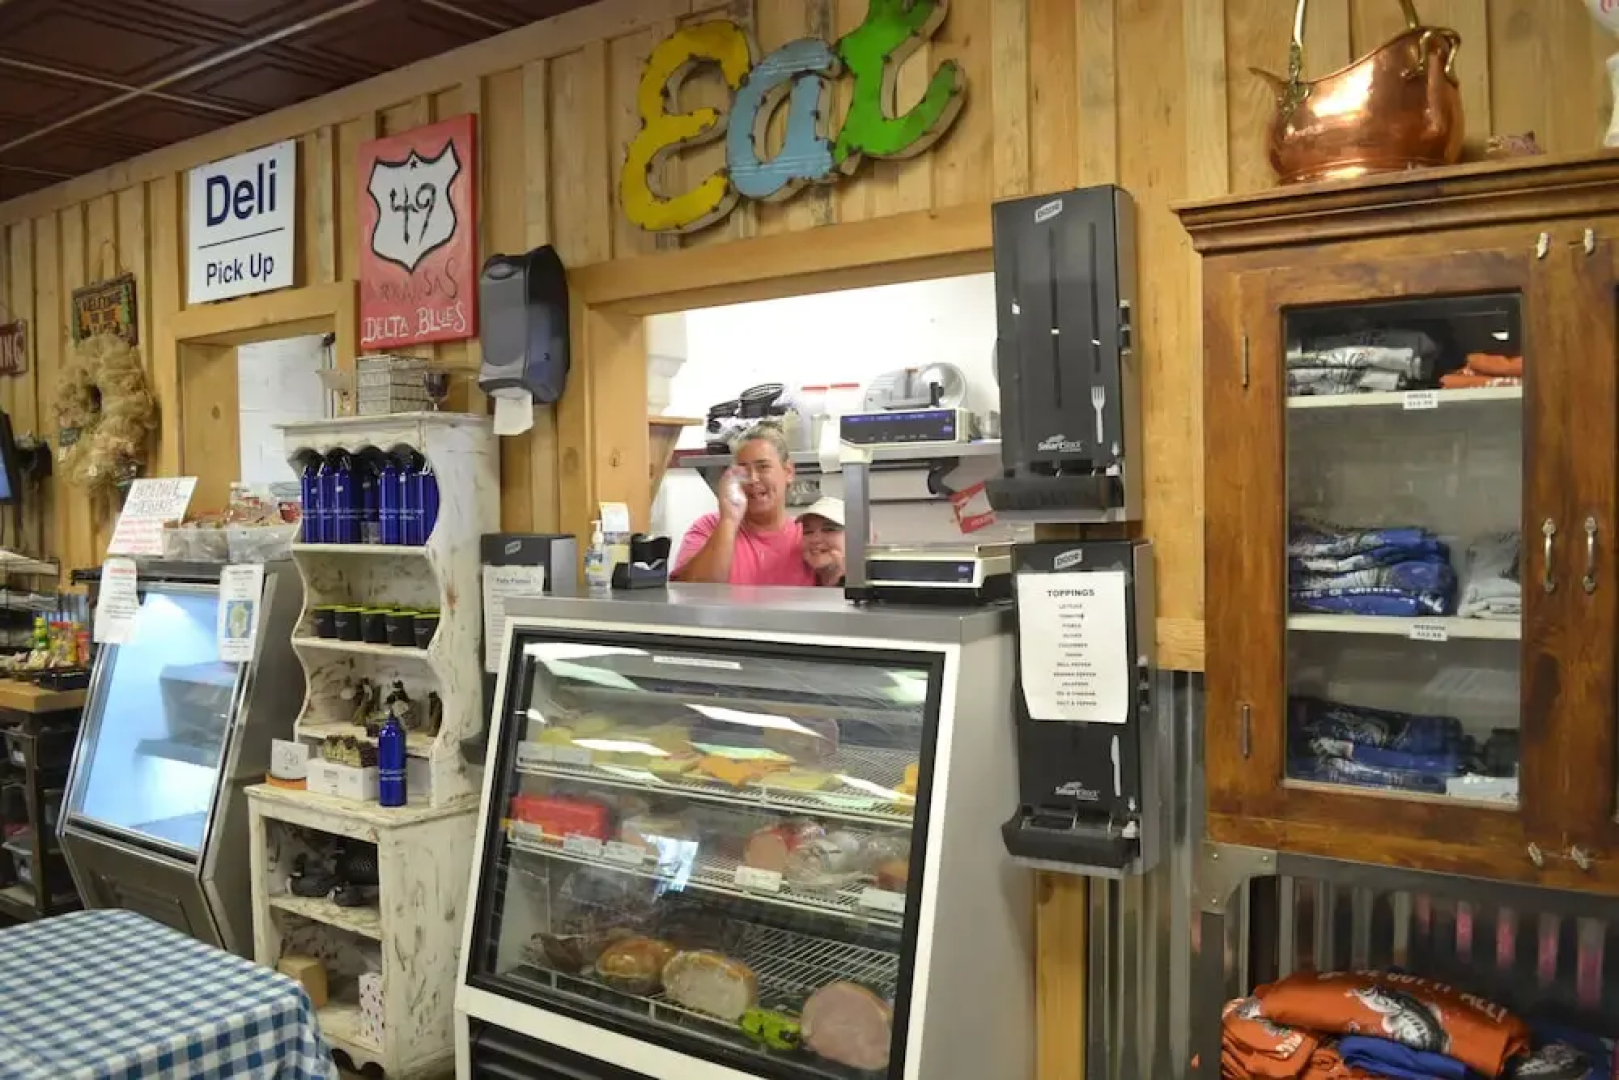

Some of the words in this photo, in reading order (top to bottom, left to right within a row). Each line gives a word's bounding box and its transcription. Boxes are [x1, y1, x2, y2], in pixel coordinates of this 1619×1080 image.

[621, 0, 967, 233] Eat
[206, 159, 277, 226] Deli
[390, 181, 437, 246] 49
[206, 259, 244, 287] Pick
[250, 252, 274, 283] Up
[361, 314, 409, 346] DELTA
[414, 300, 467, 338] BLUES
[1047, 589, 1095, 597] TOPPINGS
